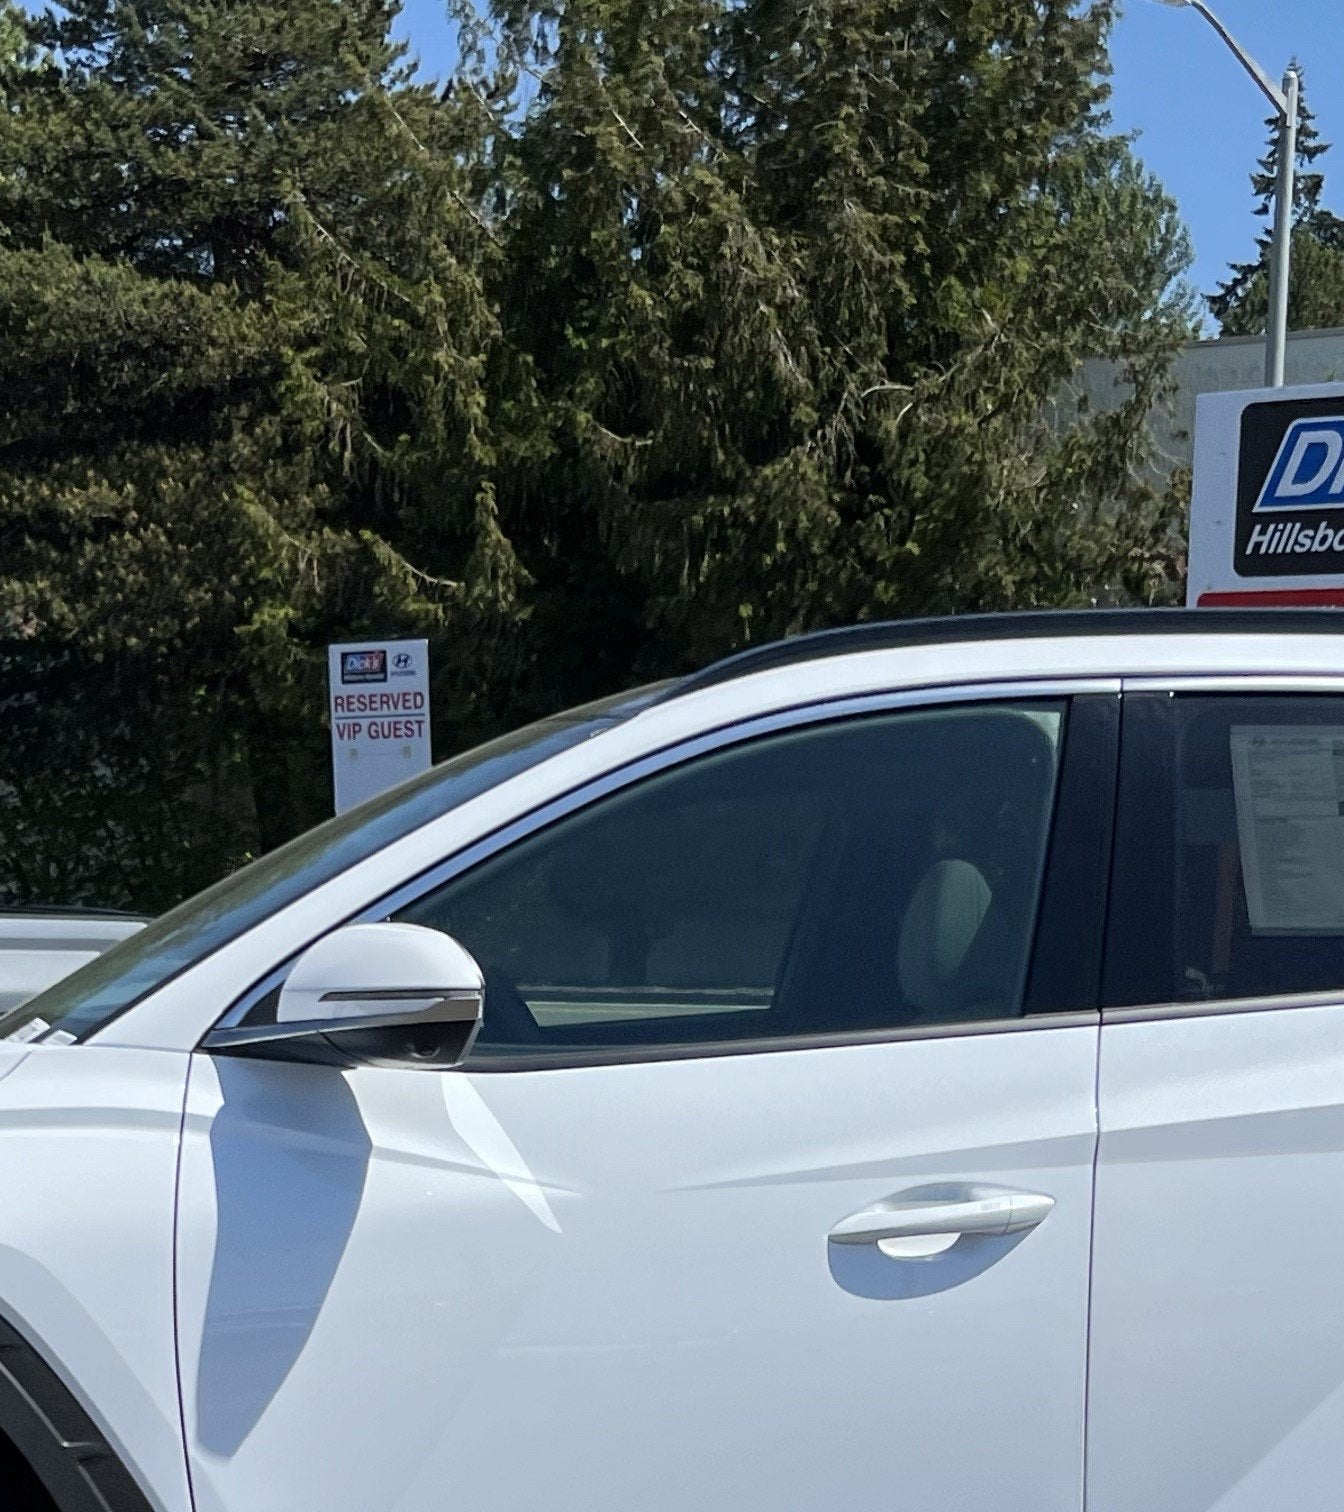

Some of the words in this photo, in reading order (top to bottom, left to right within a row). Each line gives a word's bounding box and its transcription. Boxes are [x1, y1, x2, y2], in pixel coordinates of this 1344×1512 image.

[334, 691, 425, 713] RESERVED
[336, 721, 362, 741] VIP
[368, 719, 425, 740] GUEST
